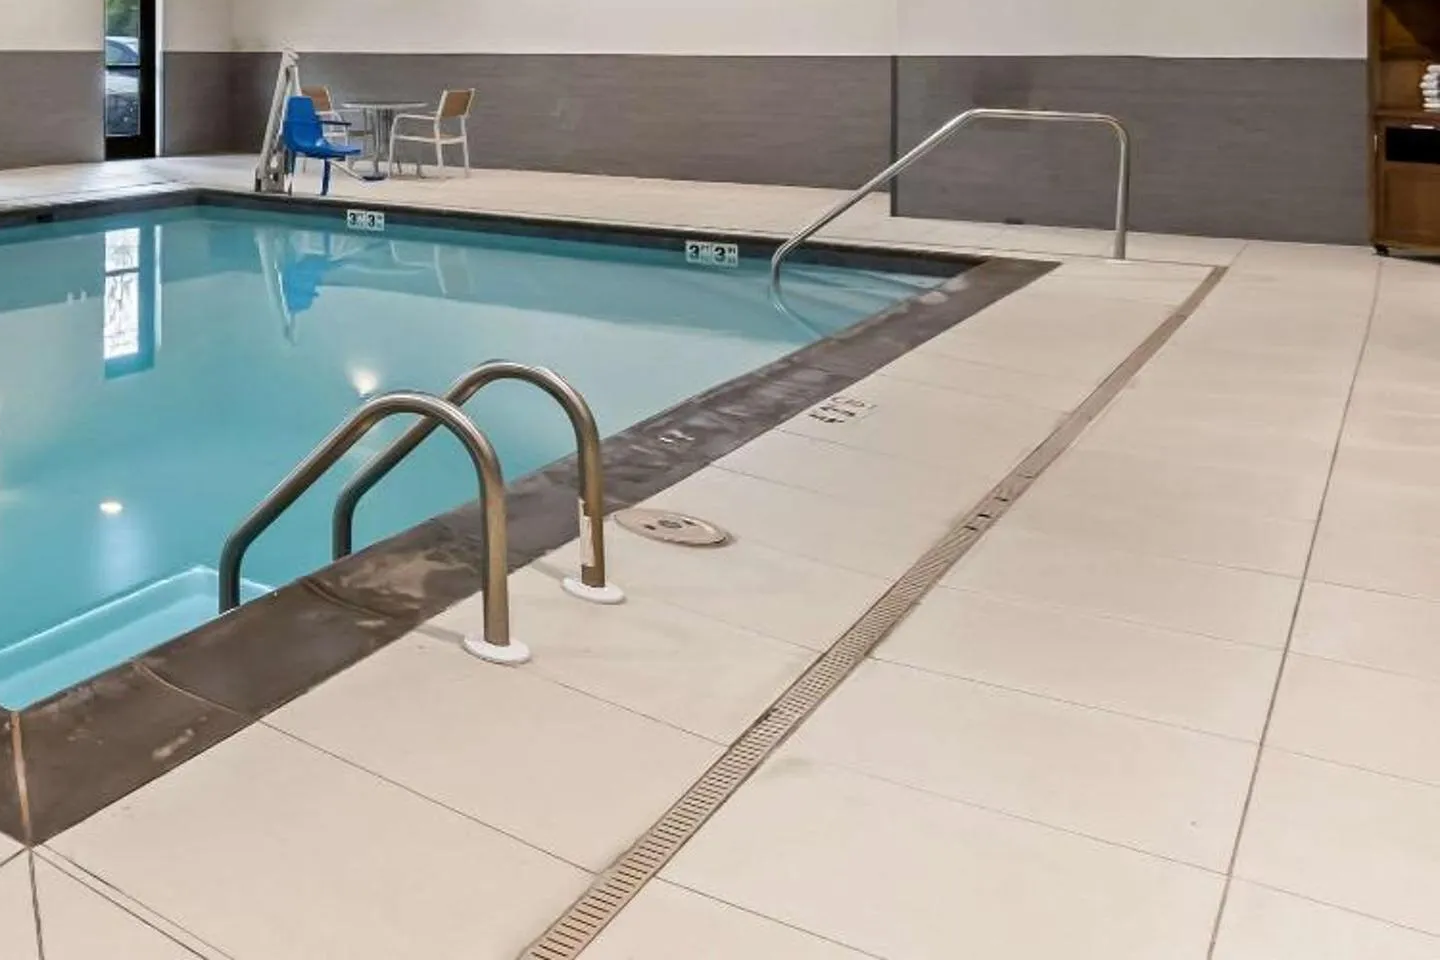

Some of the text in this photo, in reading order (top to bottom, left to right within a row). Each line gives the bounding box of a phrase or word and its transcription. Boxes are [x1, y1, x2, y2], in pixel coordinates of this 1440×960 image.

[349, 212, 357, 226] 3
[368, 214, 376, 228] 3
[689, 244, 700, 260] 3
[715, 246, 726, 262] 3
